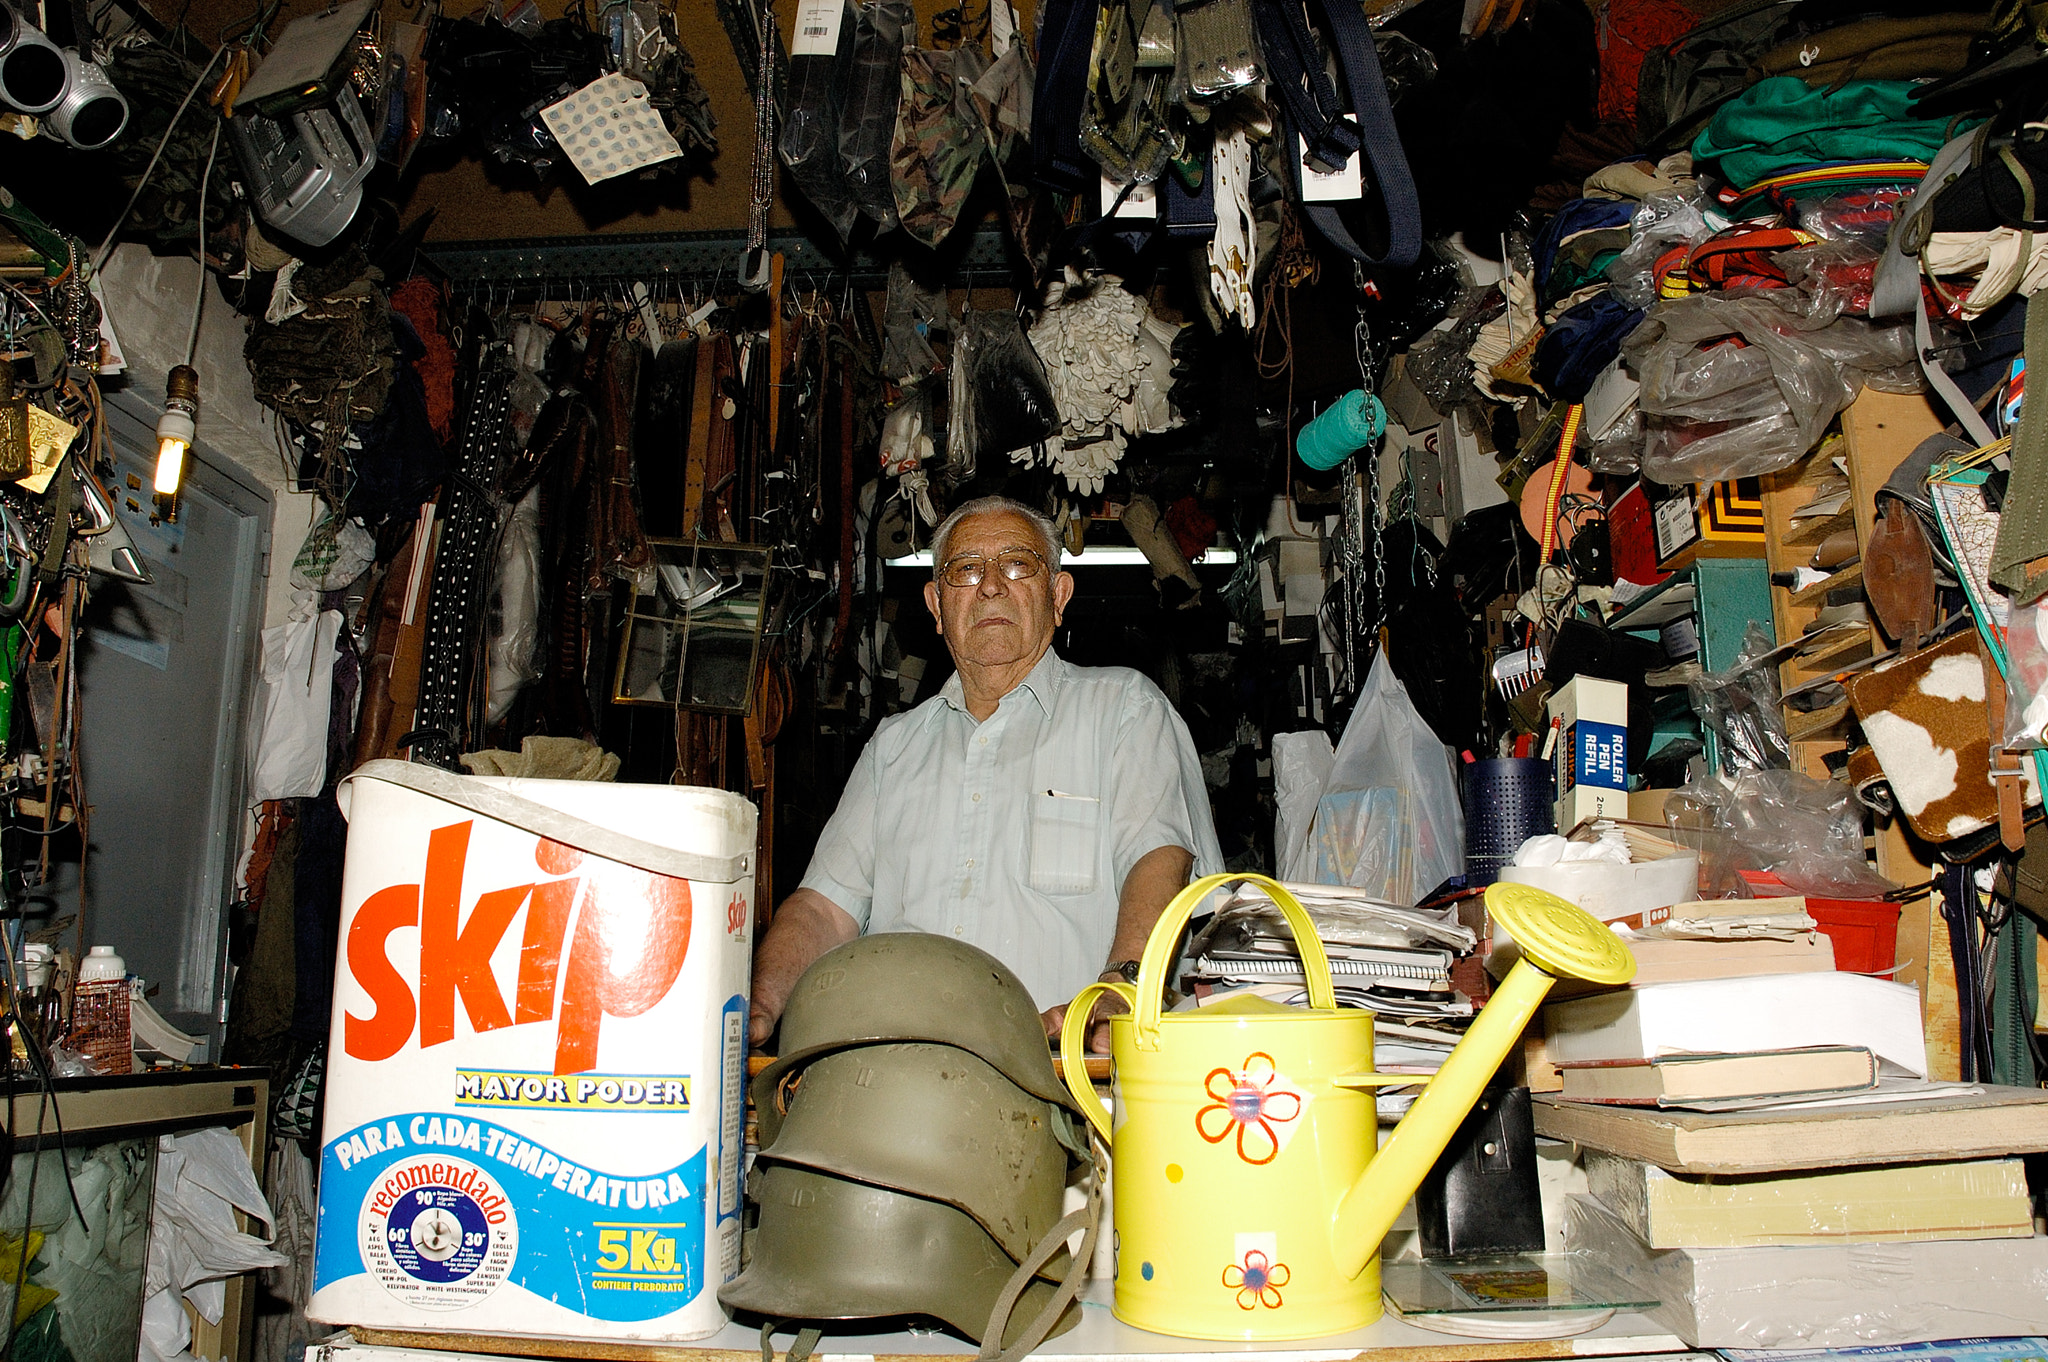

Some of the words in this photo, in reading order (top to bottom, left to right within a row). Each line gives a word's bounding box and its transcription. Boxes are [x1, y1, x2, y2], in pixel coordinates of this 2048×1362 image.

[1585, 733, 1597, 776] REFILL
[1599, 743, 1610, 770] PEN
[1612, 734, 1623, 784] ROLLER
[727, 891, 747, 936] skip
[344, 819, 692, 1076] skip
[456, 1074, 570, 1102] MAYOR
[577, 1079, 689, 1104] PODER
[334, 1120, 406, 1171] PARA
[409, 1116, 480, 1152] CADA
[485, 1127, 690, 1210] TEMPERATURA
[370, 1163, 507, 1224] recomendado
[387, 1283, 420, 1291] KELVINATOR
[592, 1280, 632, 1291] CONTIENE
[633, 1281, 685, 1292] PERBORATO
[1860, 1345, 1903, 1355] Agosto
